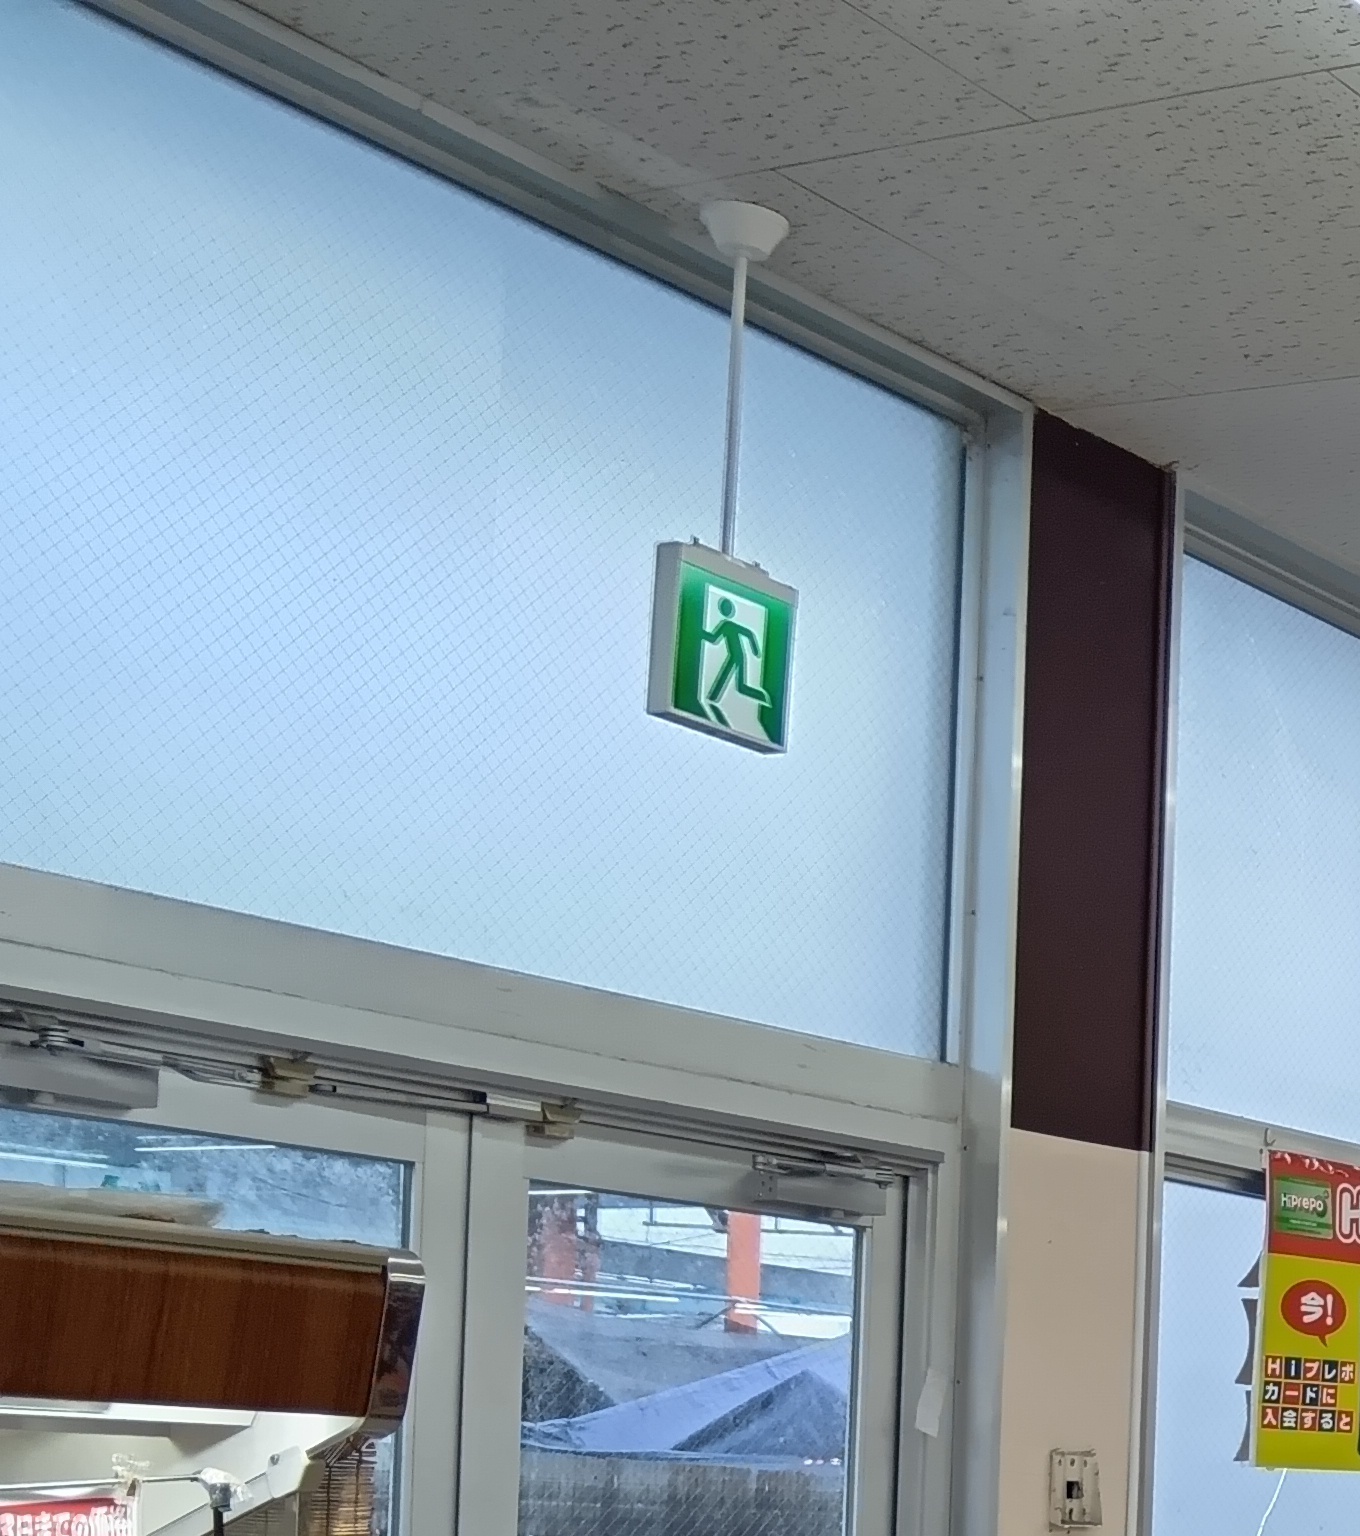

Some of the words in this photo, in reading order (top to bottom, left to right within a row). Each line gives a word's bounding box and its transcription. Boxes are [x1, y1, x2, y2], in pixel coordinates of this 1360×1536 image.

[1264, 1383, 1335, 1404] カードに
[1263, 1408, 1351, 1430] 入会すると
